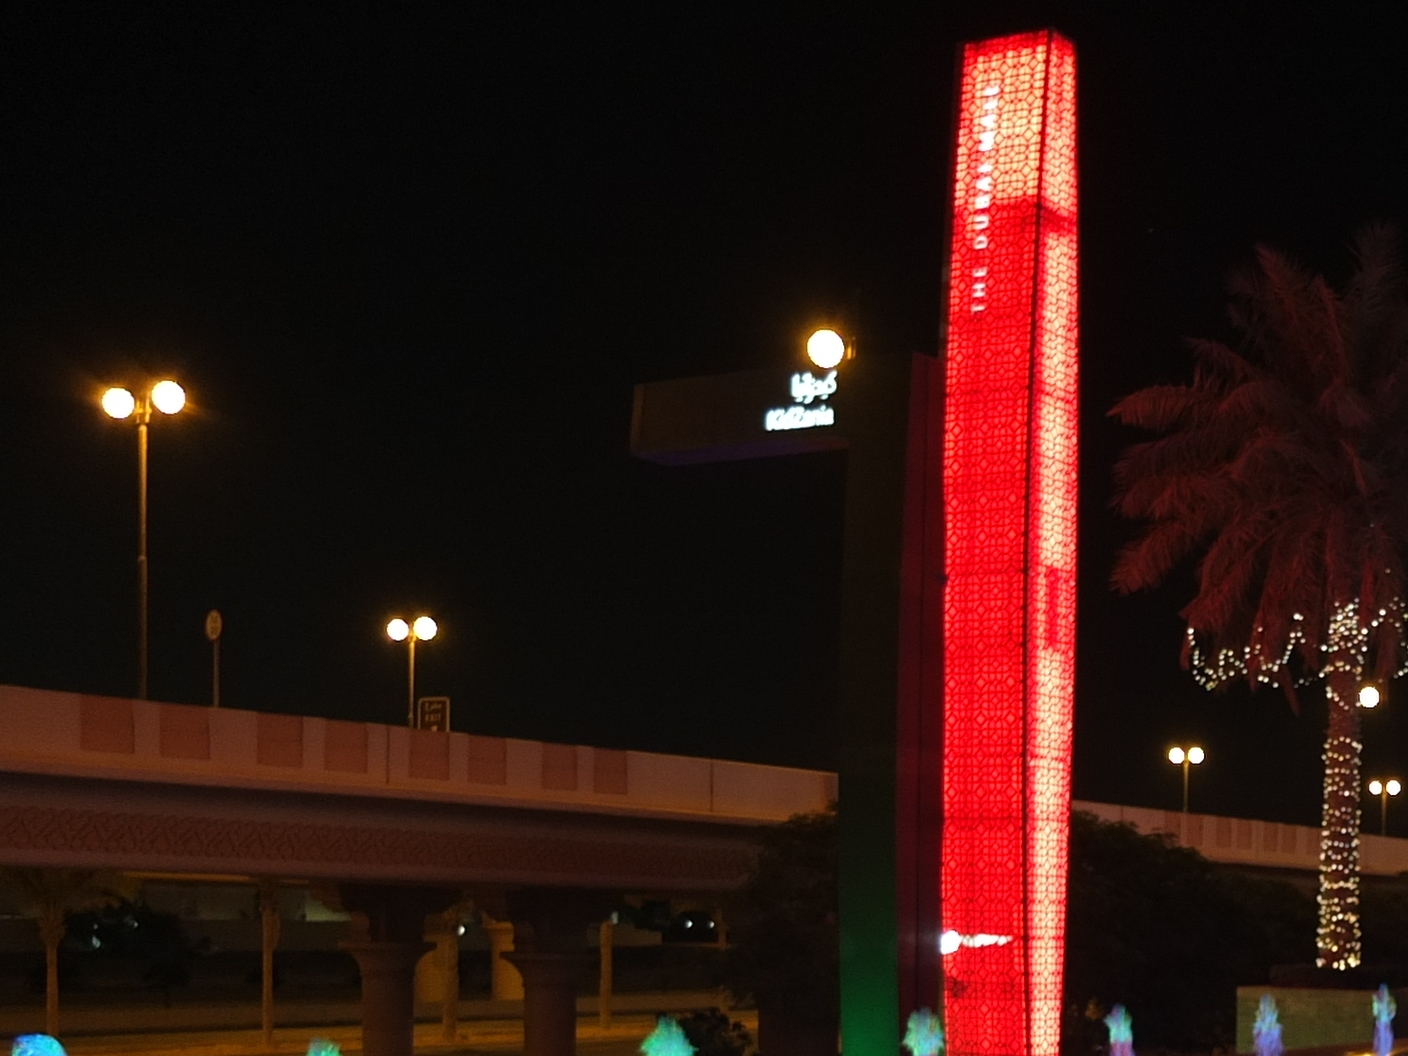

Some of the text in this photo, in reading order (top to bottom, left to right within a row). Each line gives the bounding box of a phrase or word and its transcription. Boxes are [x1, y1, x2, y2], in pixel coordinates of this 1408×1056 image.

[971, 85, 1000, 313] THE DUBAI MALL
